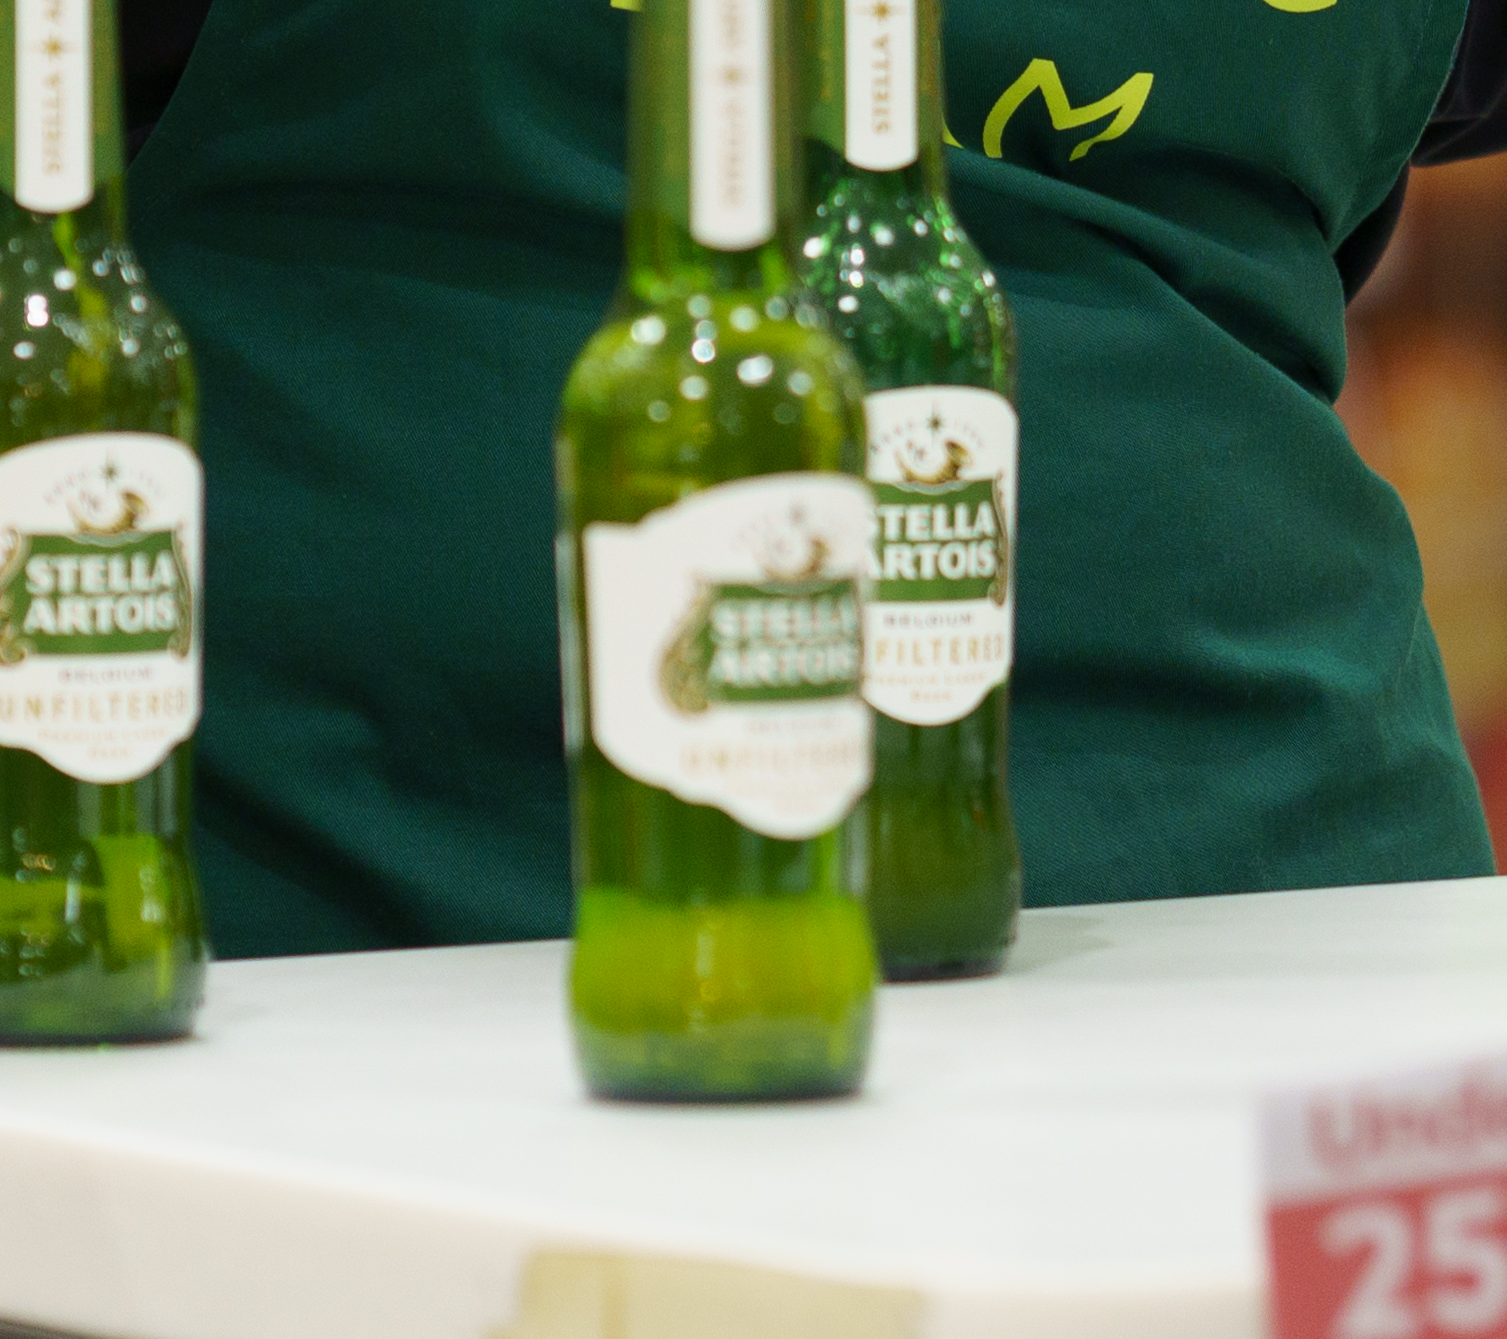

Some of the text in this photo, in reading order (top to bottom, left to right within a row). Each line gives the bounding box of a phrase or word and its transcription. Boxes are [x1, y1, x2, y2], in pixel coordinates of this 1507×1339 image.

[871, 34, 891, 136] STELLA
[871, 501, 996, 542] TELLA
[24, 550, 177, 595] STELLA
[22, 591, 178, 636] ARTOIS
